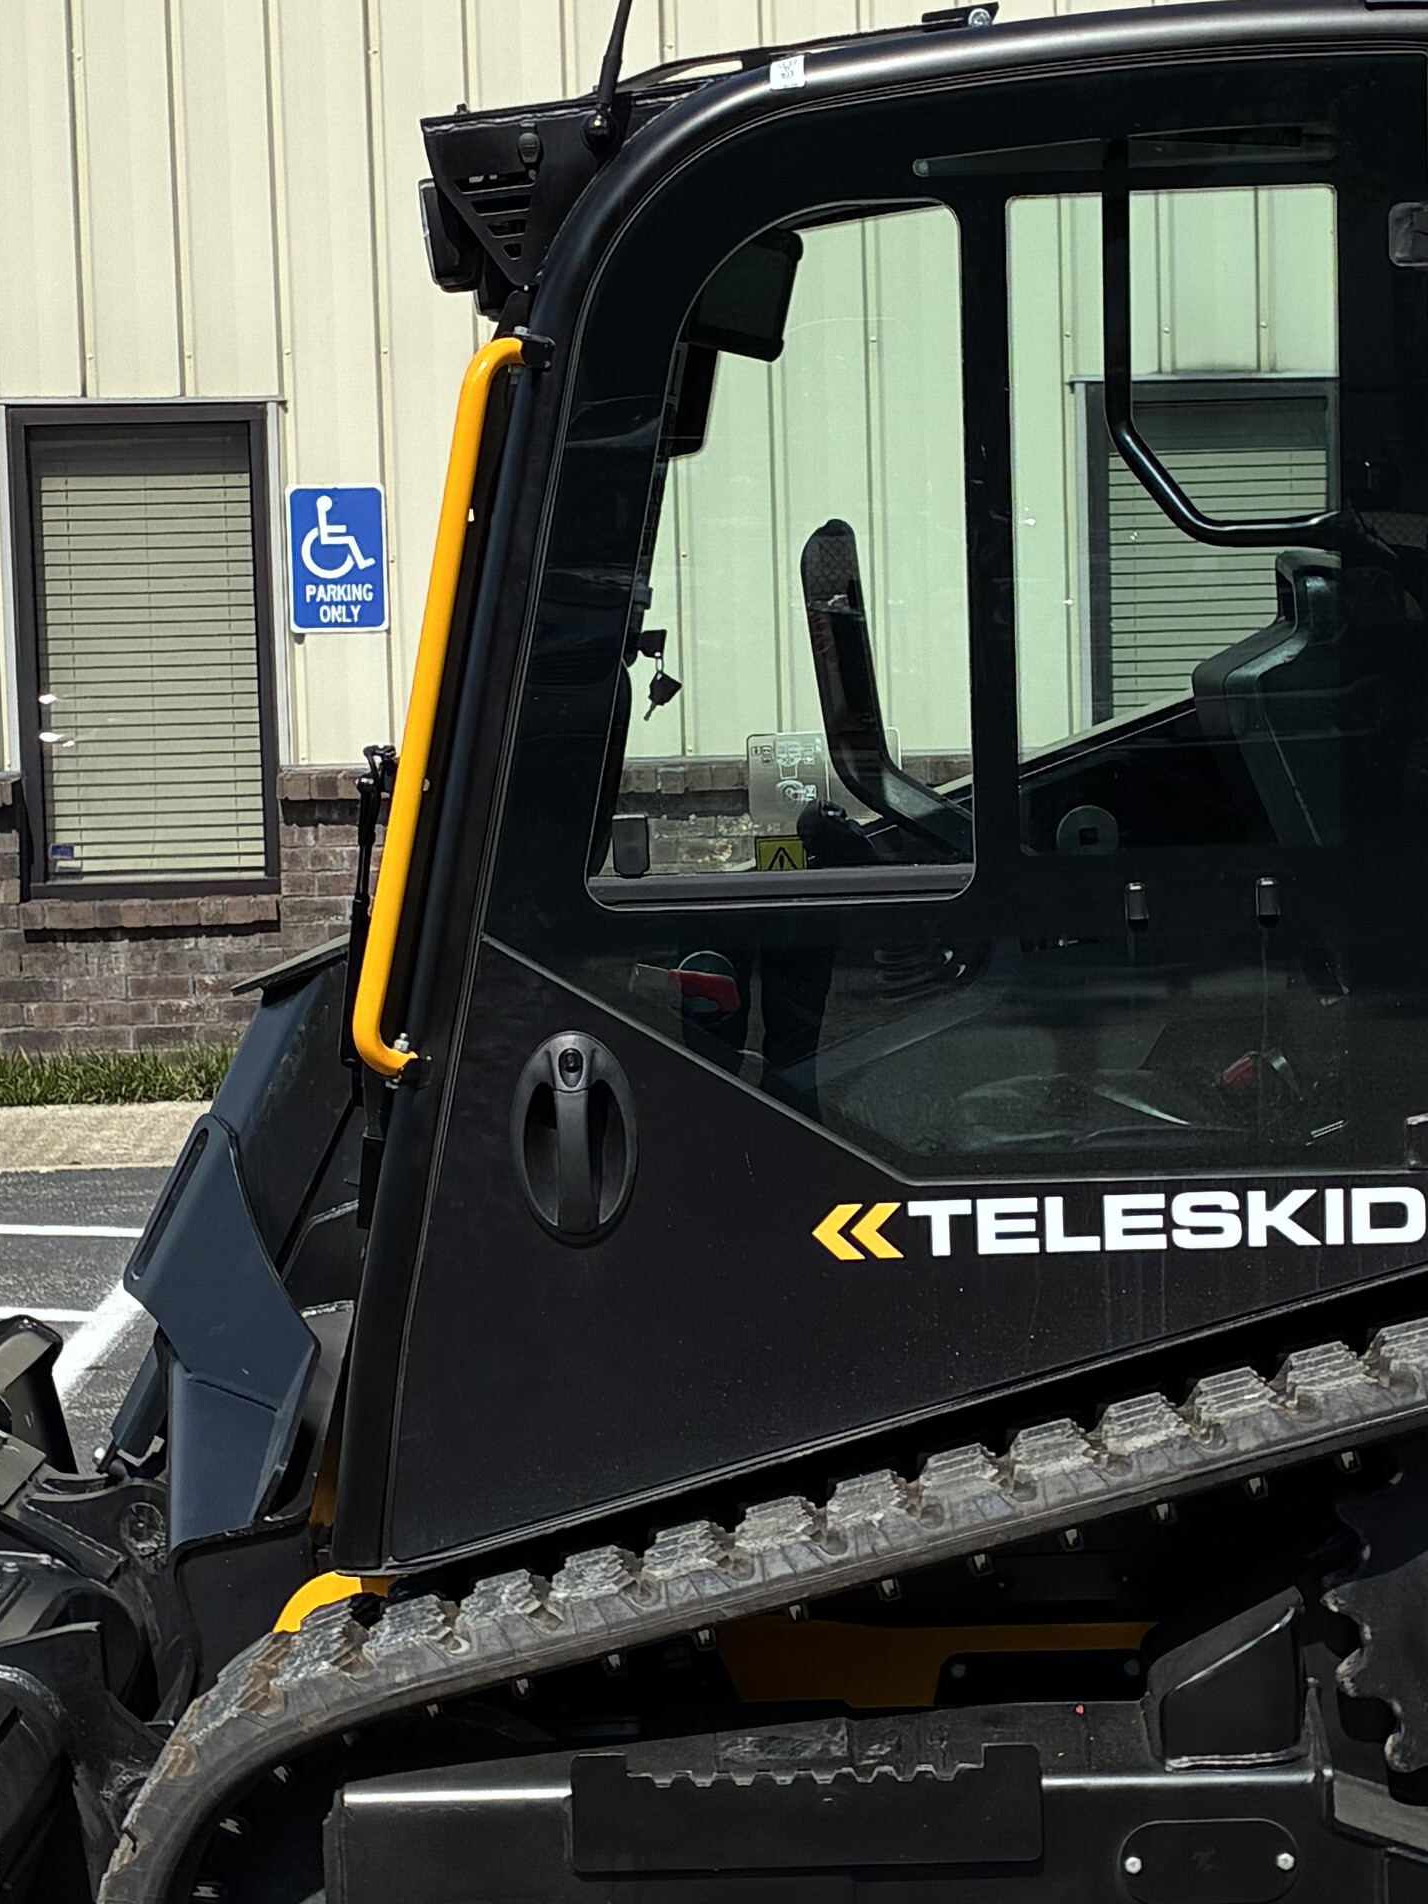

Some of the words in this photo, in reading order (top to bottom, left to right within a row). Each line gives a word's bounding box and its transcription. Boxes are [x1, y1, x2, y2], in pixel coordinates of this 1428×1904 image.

[305, 583, 374, 603] PARKING
[319, 605, 361, 623] ONLY
[907, 1186, 1427, 1257] TELESKID
